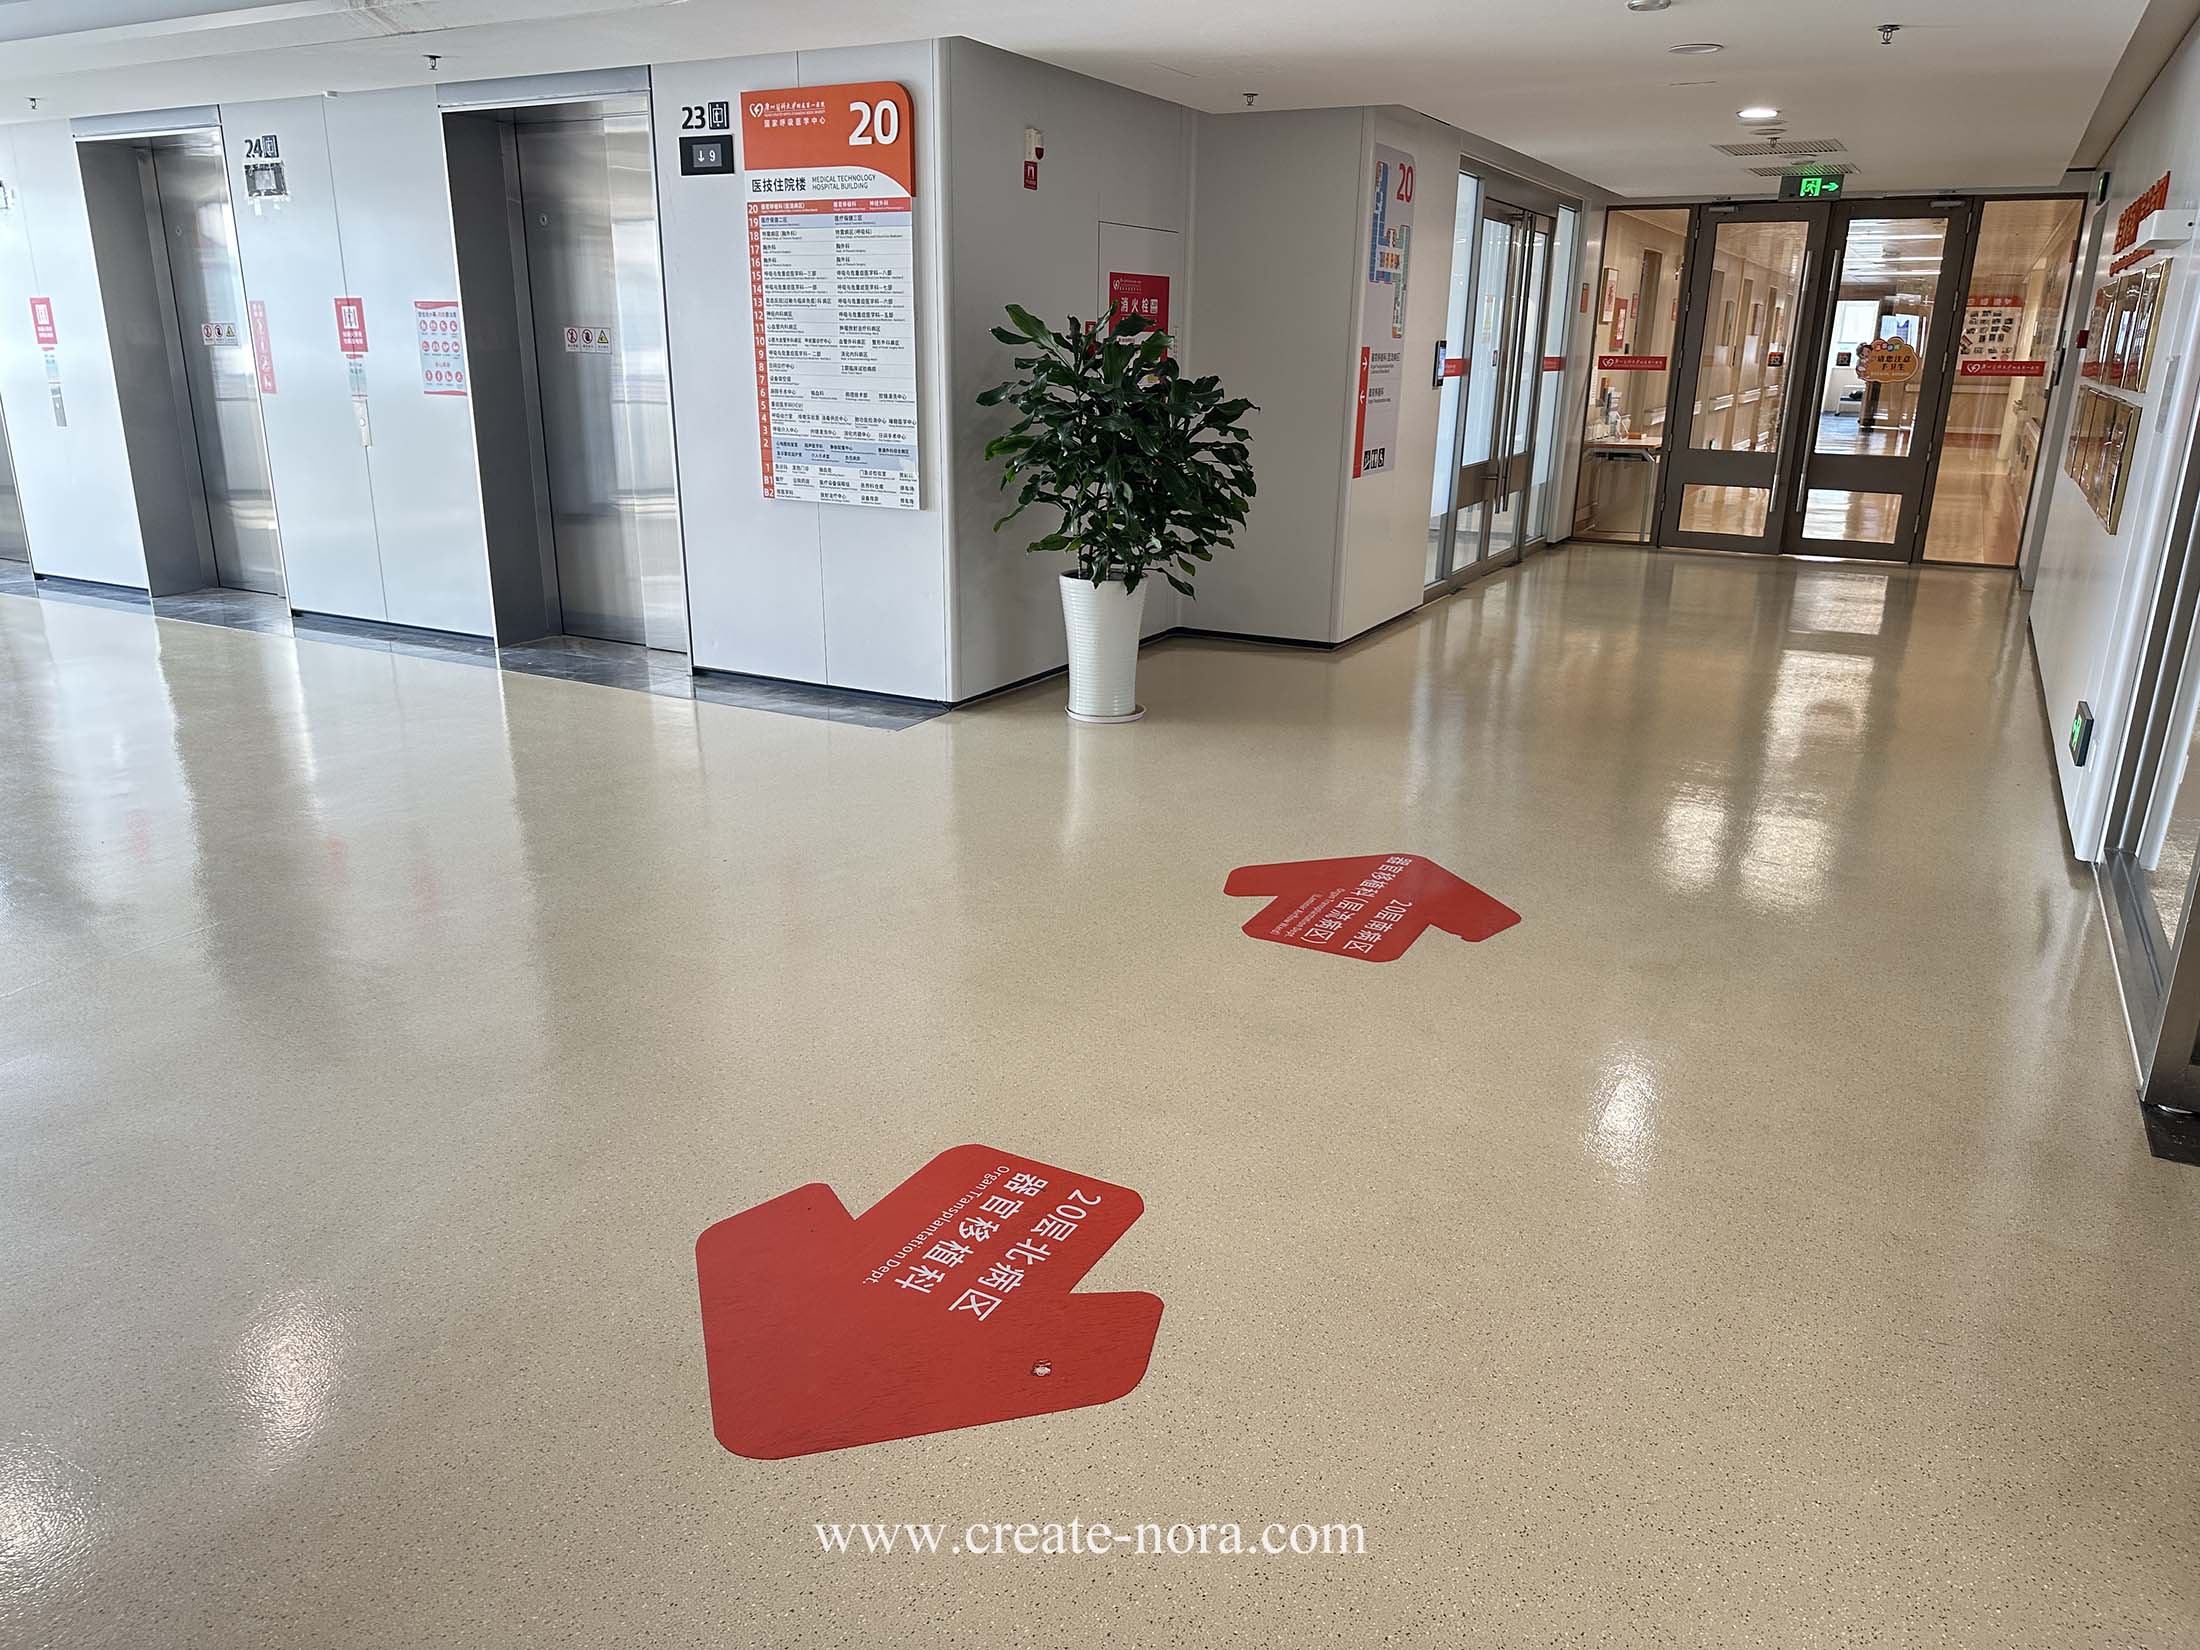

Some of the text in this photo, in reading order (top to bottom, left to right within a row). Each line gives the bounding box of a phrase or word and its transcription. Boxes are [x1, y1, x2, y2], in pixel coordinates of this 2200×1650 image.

[681, 106, 706, 130] 23
[849, 100, 898, 146] 20
[244, 138, 263, 158] 24
[709, 150, 716, 162] 9
[837, 174, 876, 183] TECHNOLOGY
[1396, 163, 1414, 203] 20
[751, 176, 806, 193] 医技住院楼
[812, 181, 869, 191] HOSPITAL BUILDING
[748, 204, 757, 213] 20
[749, 218, 758, 226] 19
[749, 231, 759, 240] 18
[750, 245, 760, 253] 17
[751, 258, 760, 266] 16
[752, 271, 761, 280] 15
[752, 285, 762, 293] 14
[753, 298, 763, 306] 13
[754, 311, 763, 319] 12
[755, 337, 765, 345] 10
[758, 350, 763, 358] 9
[759, 375, 764, 384] 7
[760, 388, 765, 396] 6
[760, 400, 765, 409] 5
[762, 426, 767, 434] 3
[762, 438, 768, 447] 2
[763, 475, 772, 484] B1
[764, 488, 773, 496] B2
[1343, 899, 1413, 953] 20层南病区
[862, 1165, 1010, 1286] Organ Transplantation Dept.
[894, 1171, 1049, 1294] 器官移植科
[948, 1188, 1102, 1322] 20层北病区
